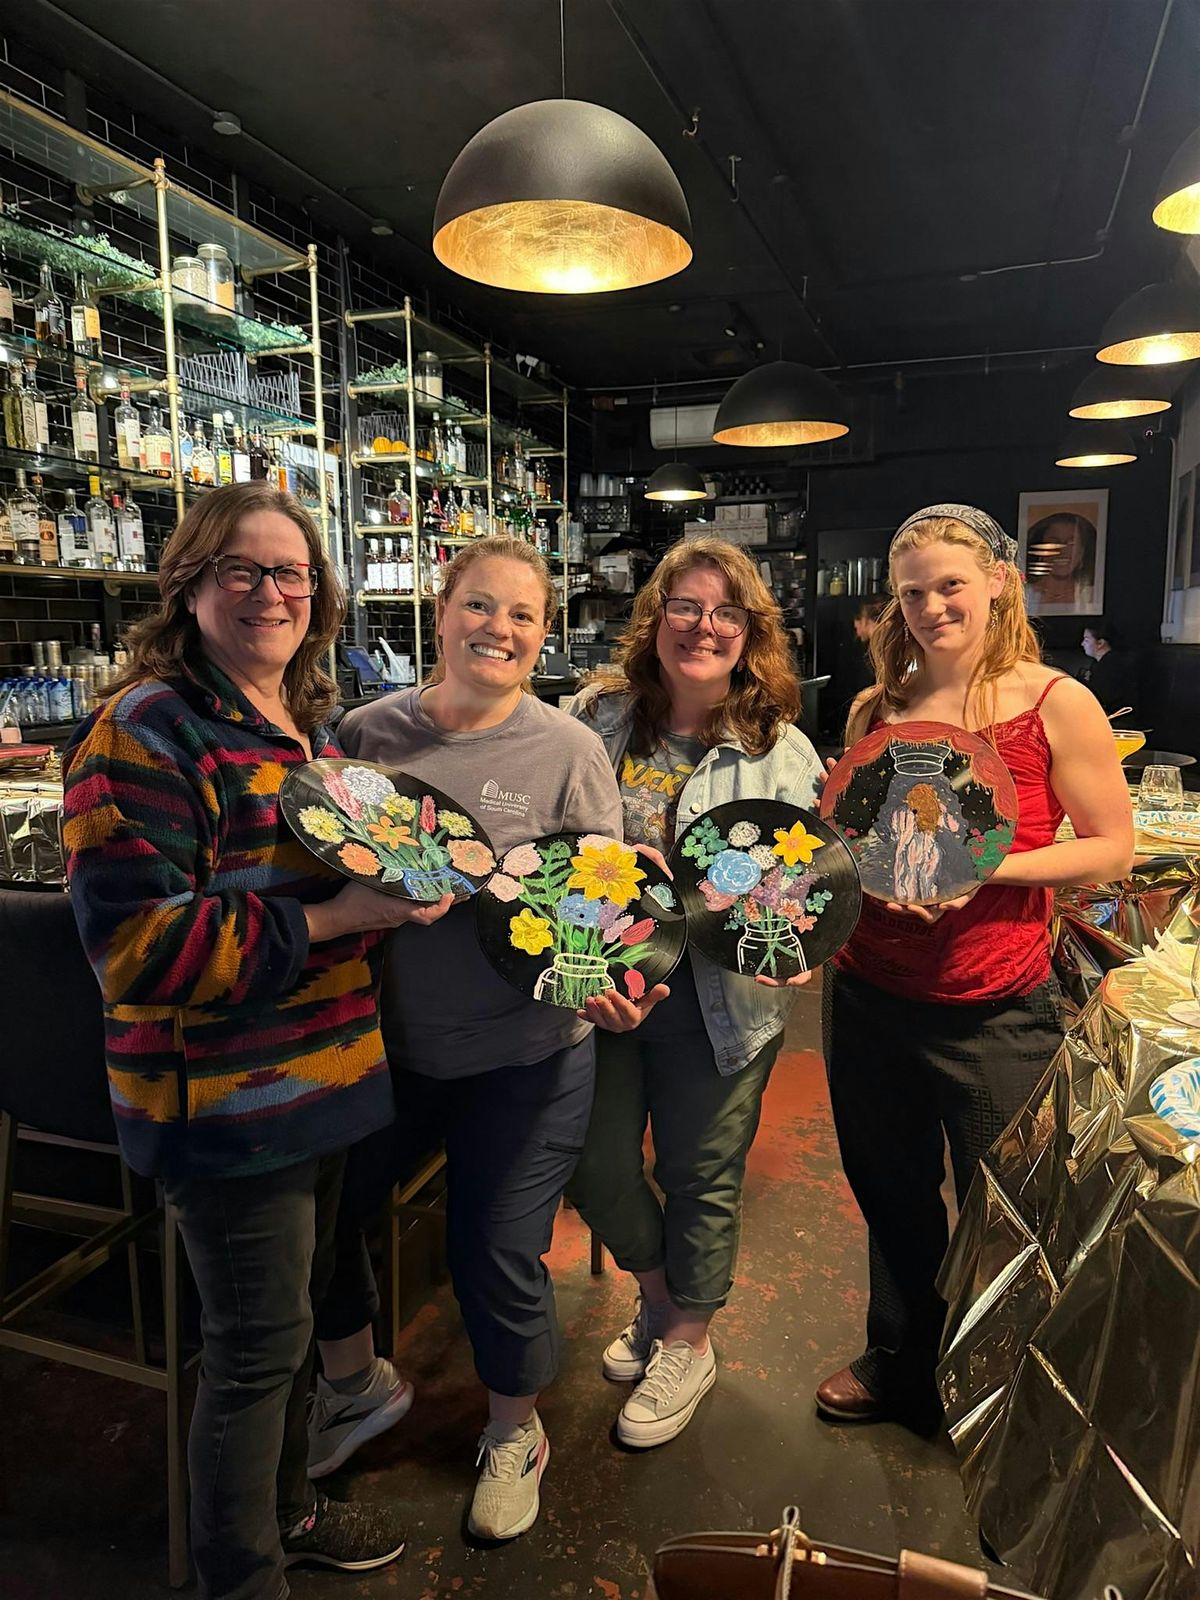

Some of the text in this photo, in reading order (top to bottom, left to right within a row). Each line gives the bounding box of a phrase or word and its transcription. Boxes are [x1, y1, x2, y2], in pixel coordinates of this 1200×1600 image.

[480, 797, 529, 812] Medical University
[498, 790, 531, 805] MUSC
[503, 807, 525, 817] Carolina
